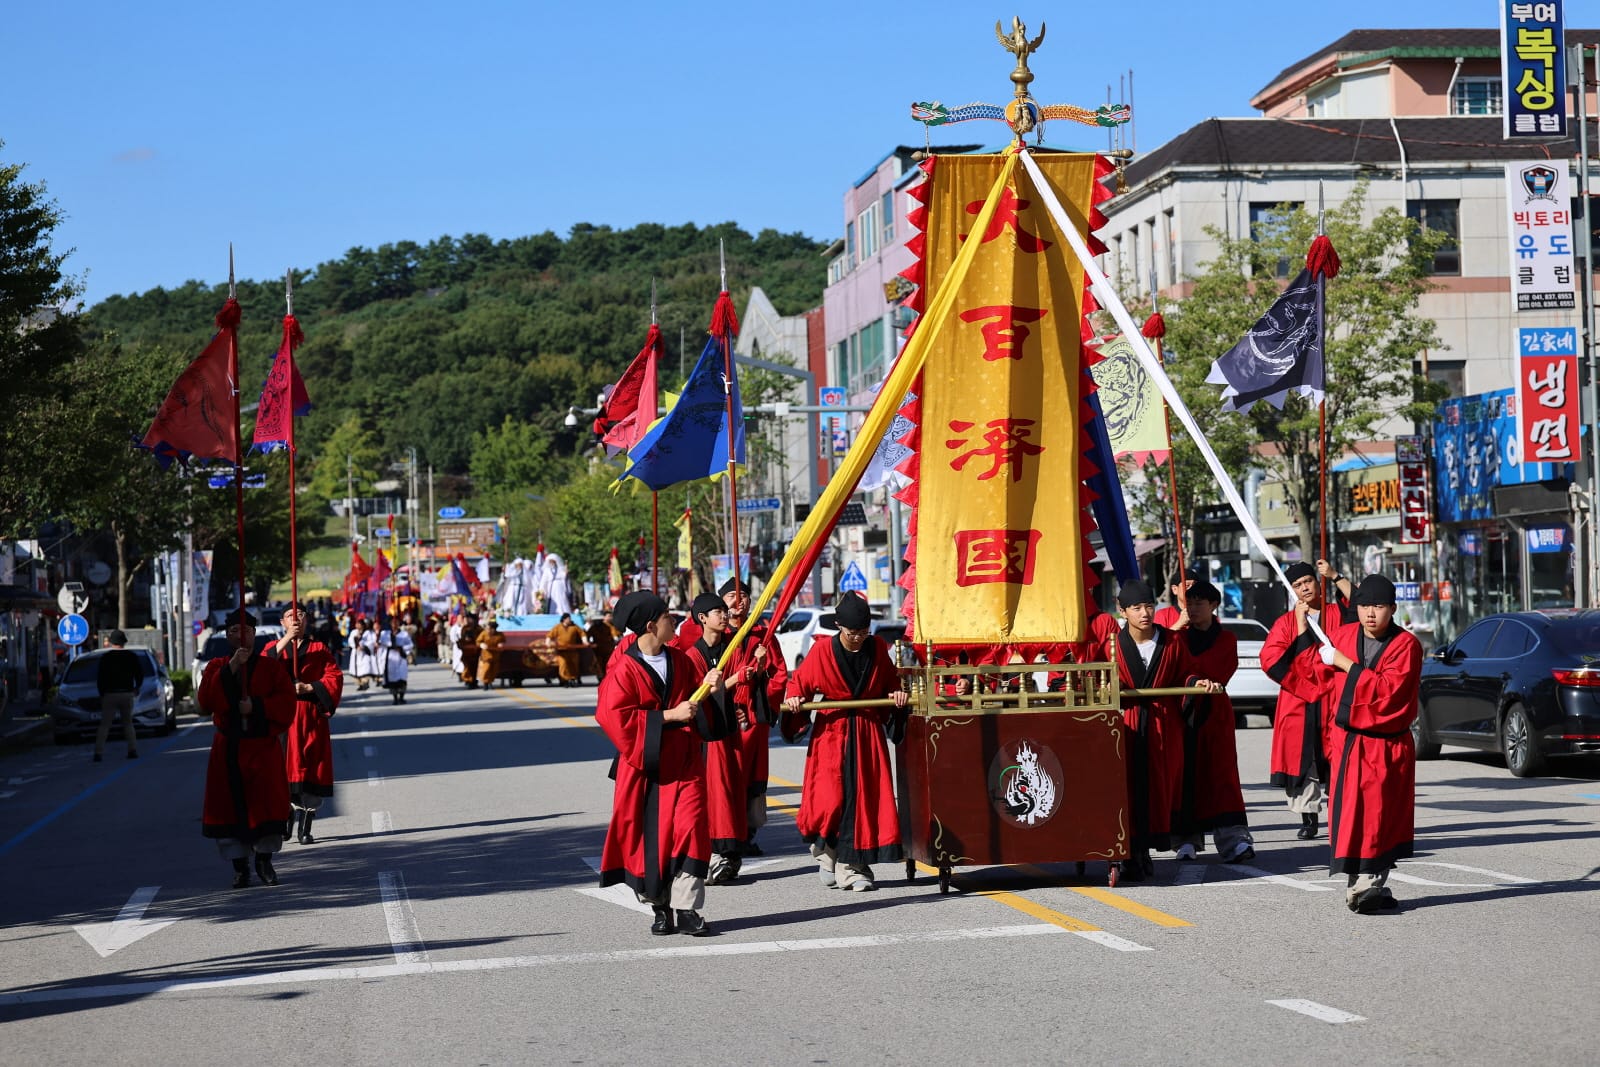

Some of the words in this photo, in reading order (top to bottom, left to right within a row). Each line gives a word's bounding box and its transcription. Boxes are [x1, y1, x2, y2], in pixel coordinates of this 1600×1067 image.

[1511, 3, 1556, 23] 부여
[1515, 28, 1557, 111] 복싱
[1515, 114, 1560, 132] 클럽
[1513, 210, 1569, 230] 빅토리
[1516, 234, 1571, 259] 유도
[1518, 265, 1569, 285] 클럽
[1522, 332, 1573, 352] 김家네
[1528, 359, 1571, 458] 냉면
[1403, 465, 1430, 540] 보신탕
